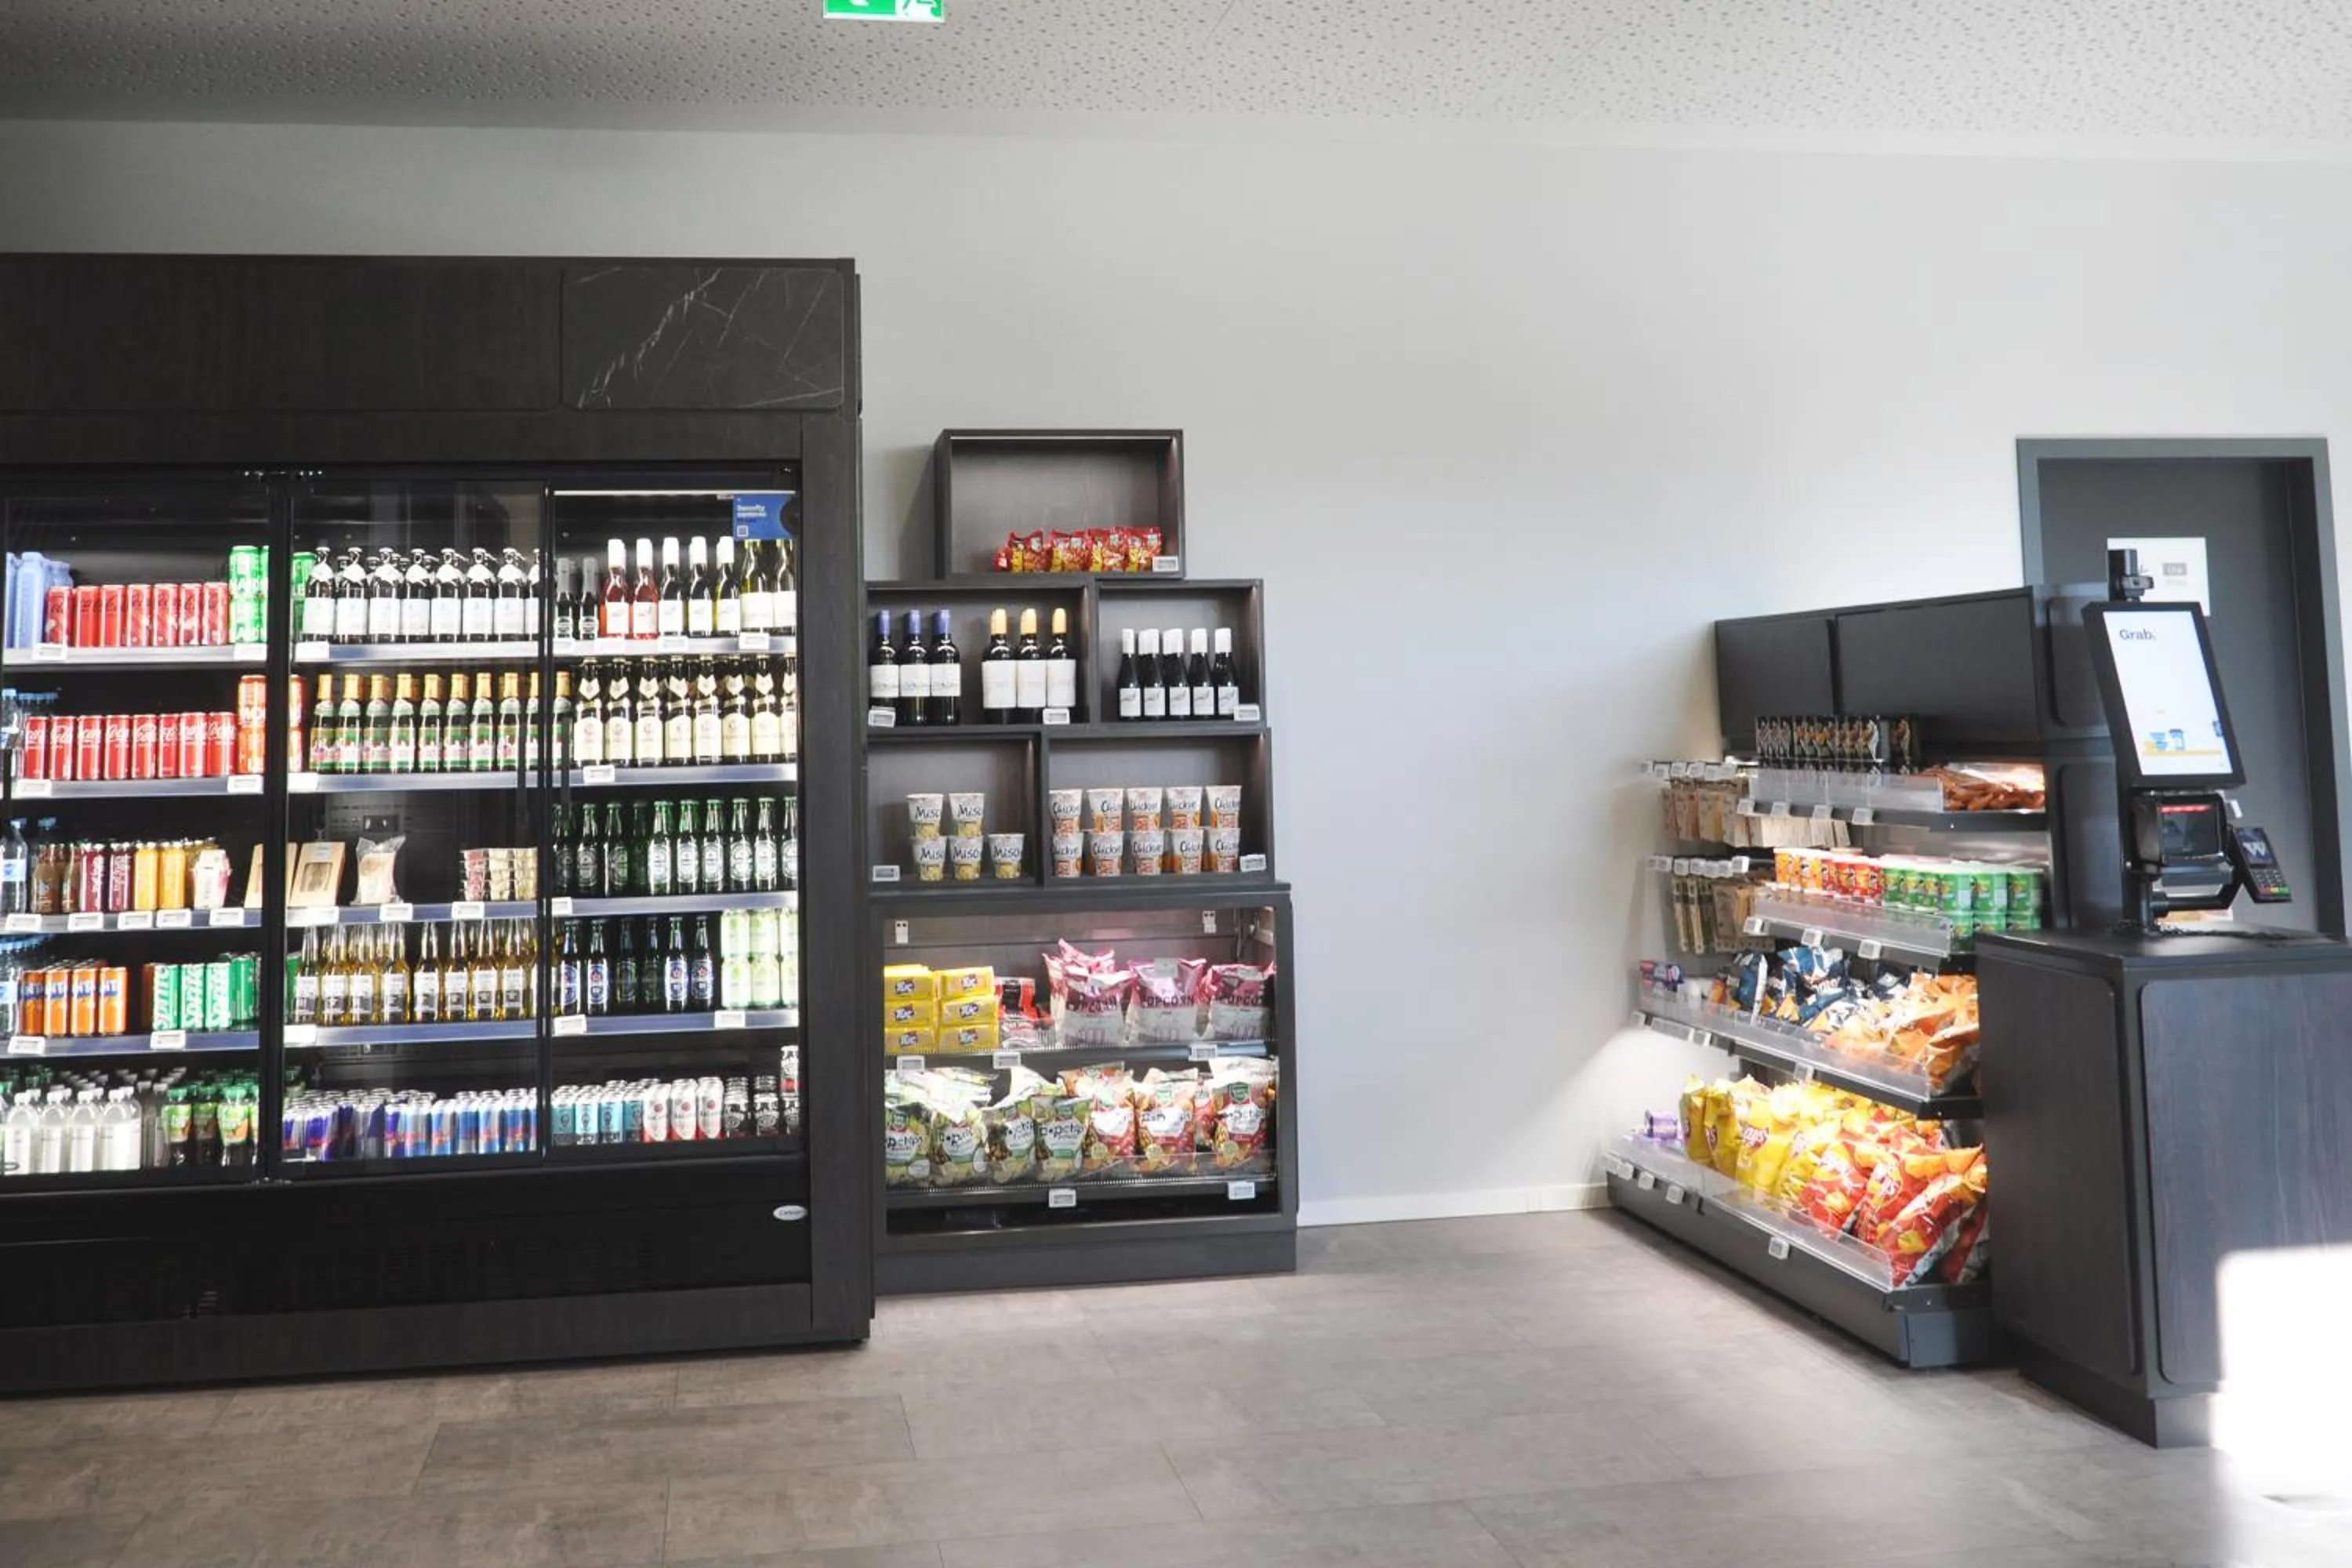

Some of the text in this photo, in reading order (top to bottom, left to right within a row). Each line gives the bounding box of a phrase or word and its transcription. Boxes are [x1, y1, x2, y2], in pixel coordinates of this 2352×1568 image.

[2119, 628, 2157, 641] Grab.
[952, 846, 980, 860] Miso
[993, 844, 1020, 859] Miso
